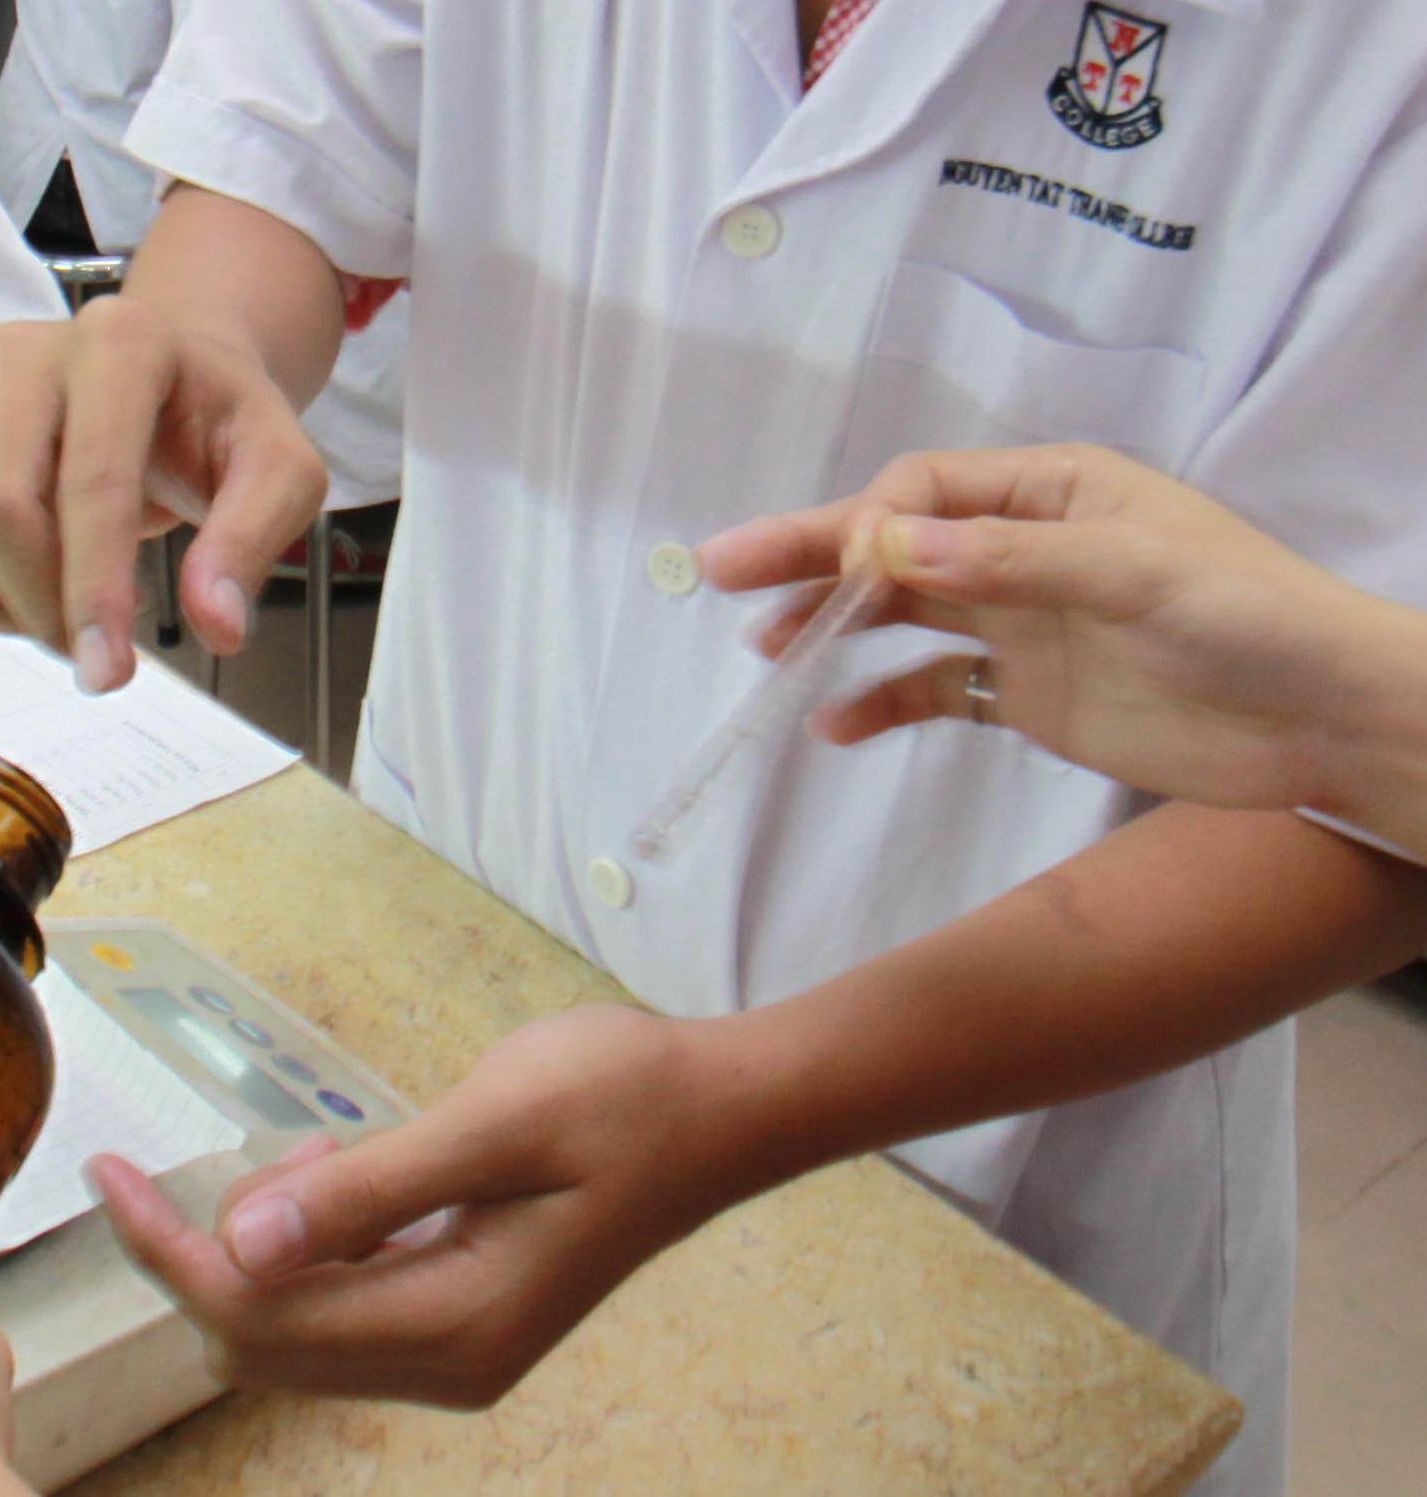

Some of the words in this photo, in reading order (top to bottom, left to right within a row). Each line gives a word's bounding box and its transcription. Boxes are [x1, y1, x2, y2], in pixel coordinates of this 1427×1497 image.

[1081, 61, 1107, 91] T
[1118, 74, 1144, 103] T
[1051, 94, 1156, 147] COLLEGE
[1025, 173, 1065, 208] TAT
